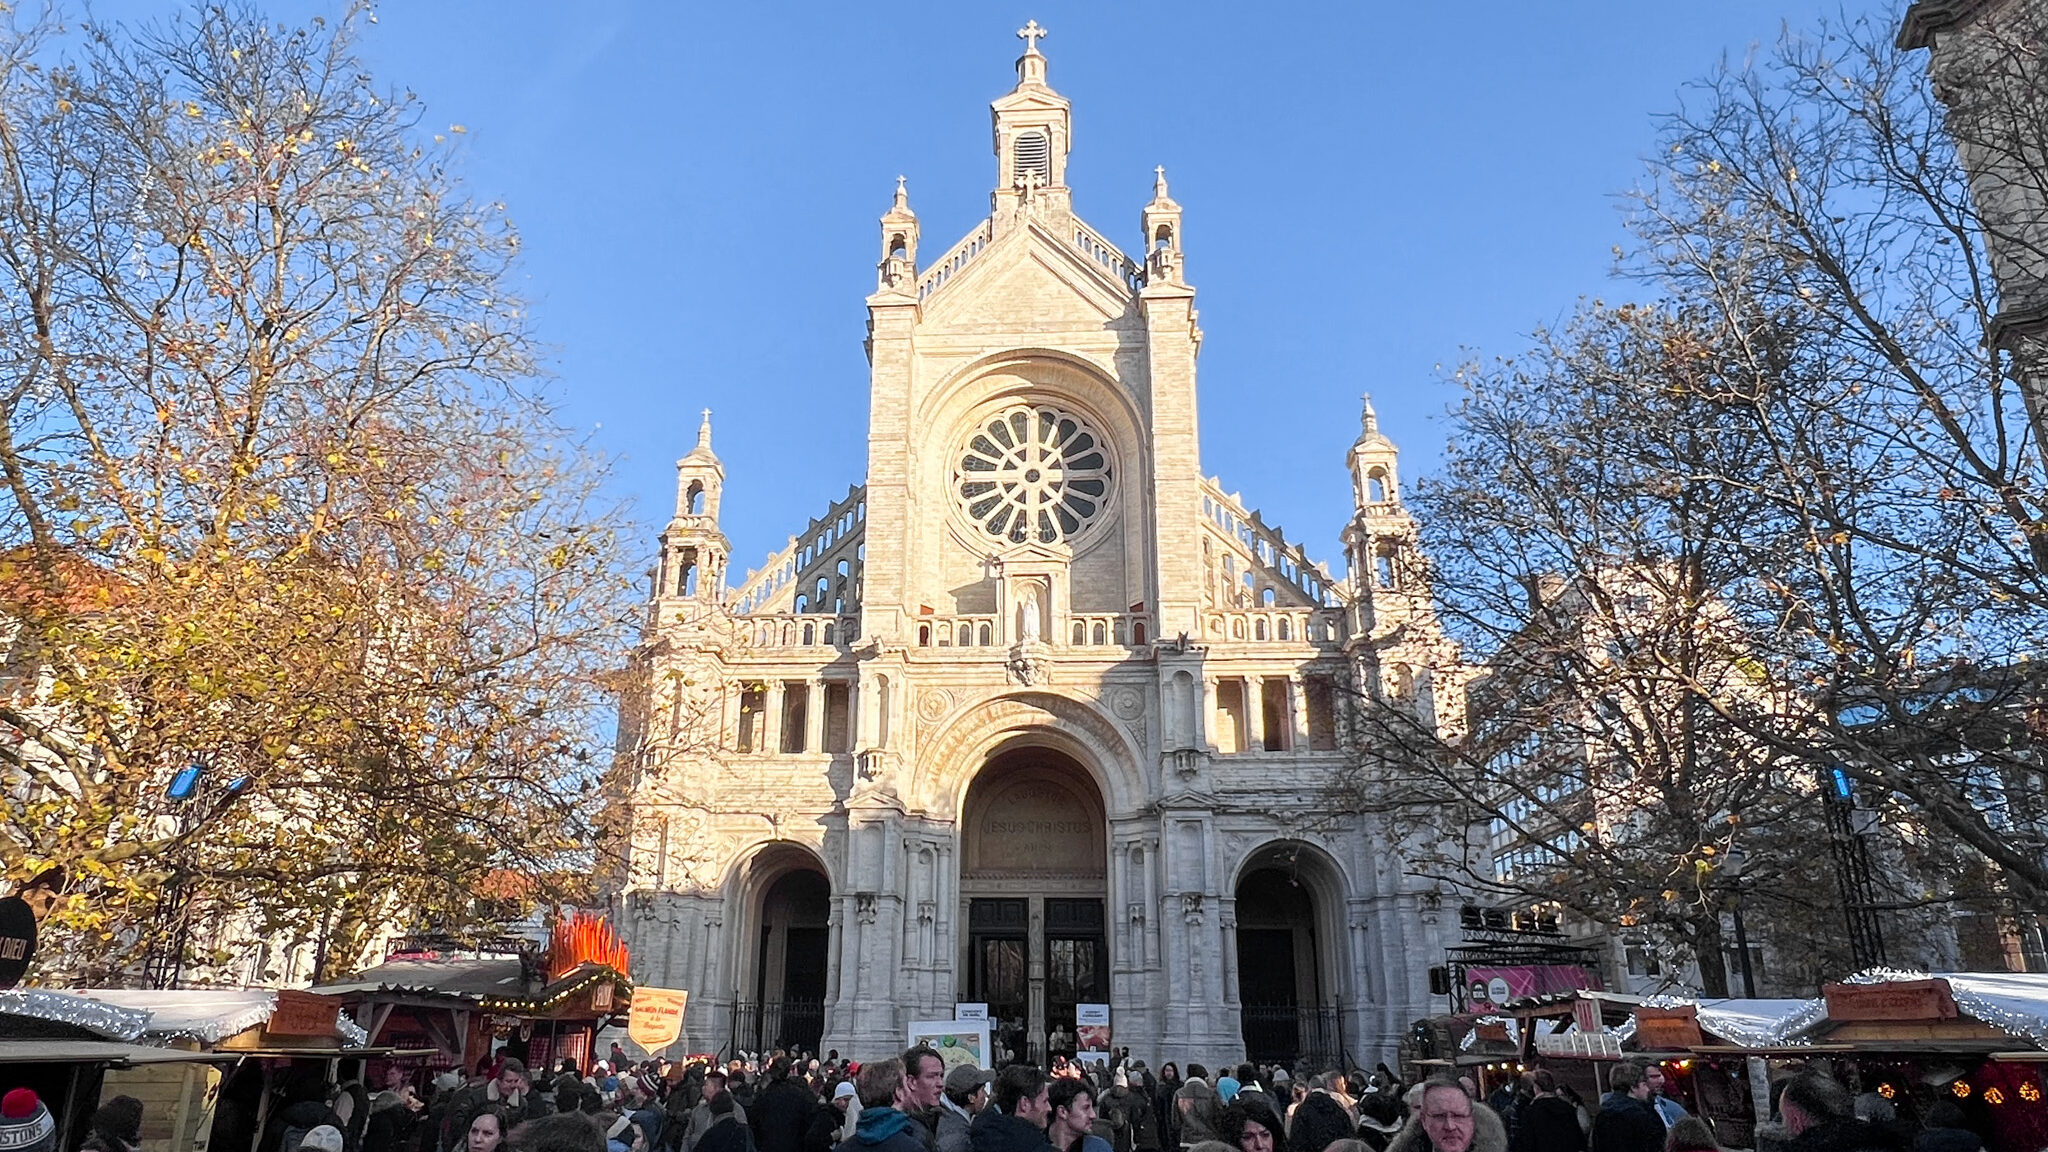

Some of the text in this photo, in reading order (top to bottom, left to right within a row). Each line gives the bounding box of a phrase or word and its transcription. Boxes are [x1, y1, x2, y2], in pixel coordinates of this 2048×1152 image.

[984, 817, 1093, 834] JESUS CHRISTUS
[1, 937, 28, 960] DIEU
